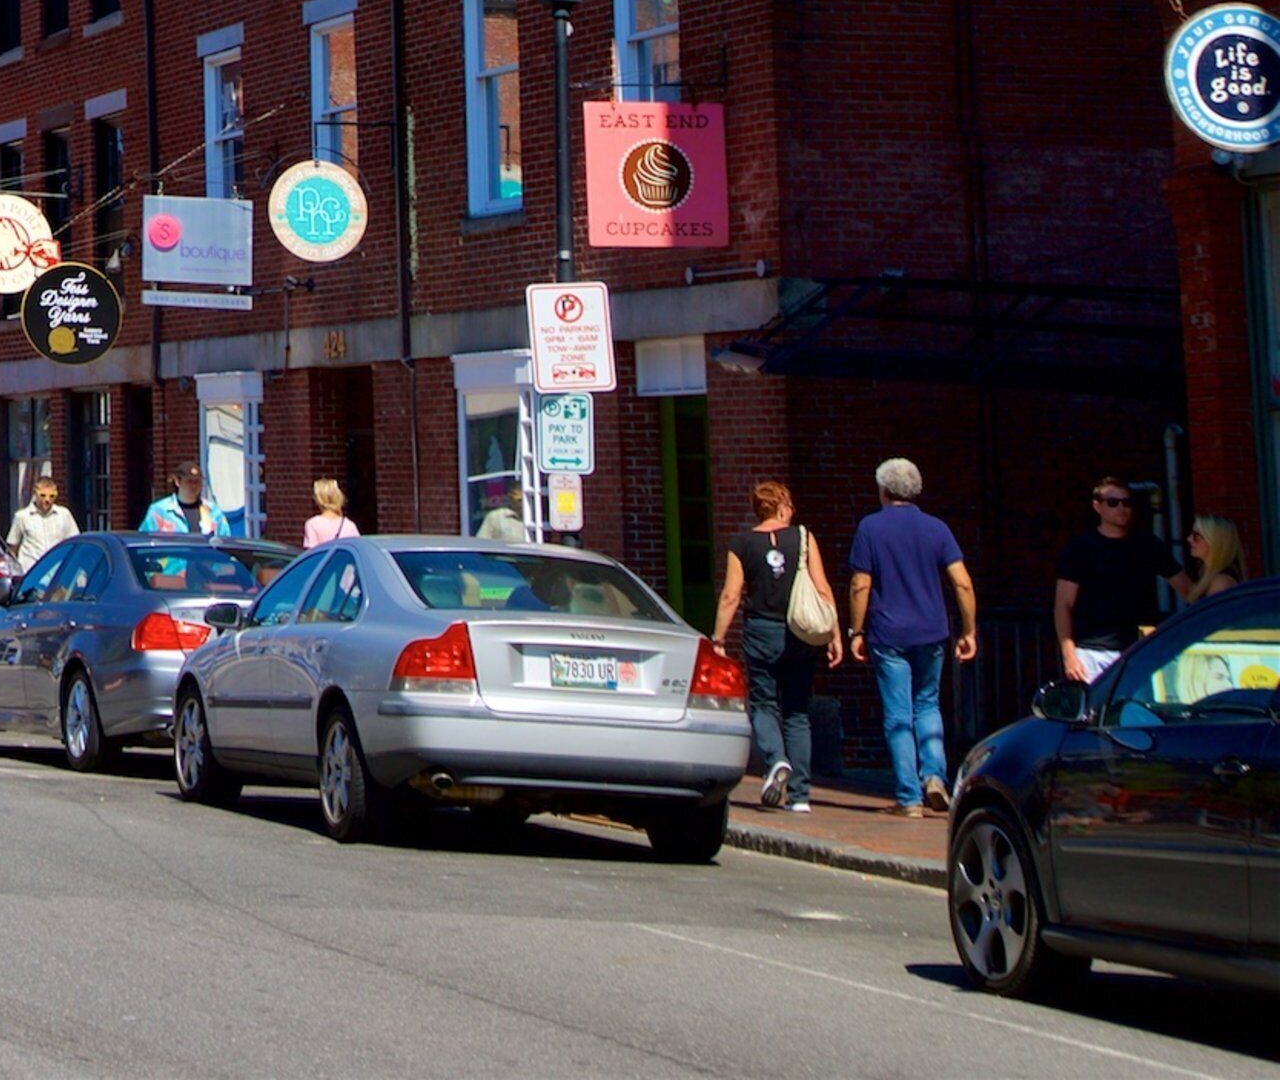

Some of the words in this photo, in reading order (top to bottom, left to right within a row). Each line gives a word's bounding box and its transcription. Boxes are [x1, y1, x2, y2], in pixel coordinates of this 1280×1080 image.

[1178, 19, 1215, 59] your
[1214, 42, 1260, 68] Life
[1231, 65, 1252, 80] is
[600, 114, 655, 128] EAST
[665, 114, 709, 129] END
[9, 203, 43, 230] PORT
[606, 222, 713, 236] CUPCAKES
[180, 240, 246, 264] boutique
[60, 272, 89, 295] Tess
[40, 289, 98, 312] Designer
[48, 306, 91, 328] Yarns
[559, 325, 601, 333] PARKING
[324, 331, 345, 358] 424
[549, 424, 566, 434] PAY
[571, 424, 583, 434] TO
[553, 435, 578, 444] PARK
[564, 661, 595, 679] 7830
[598, 663, 615, 680] UR
